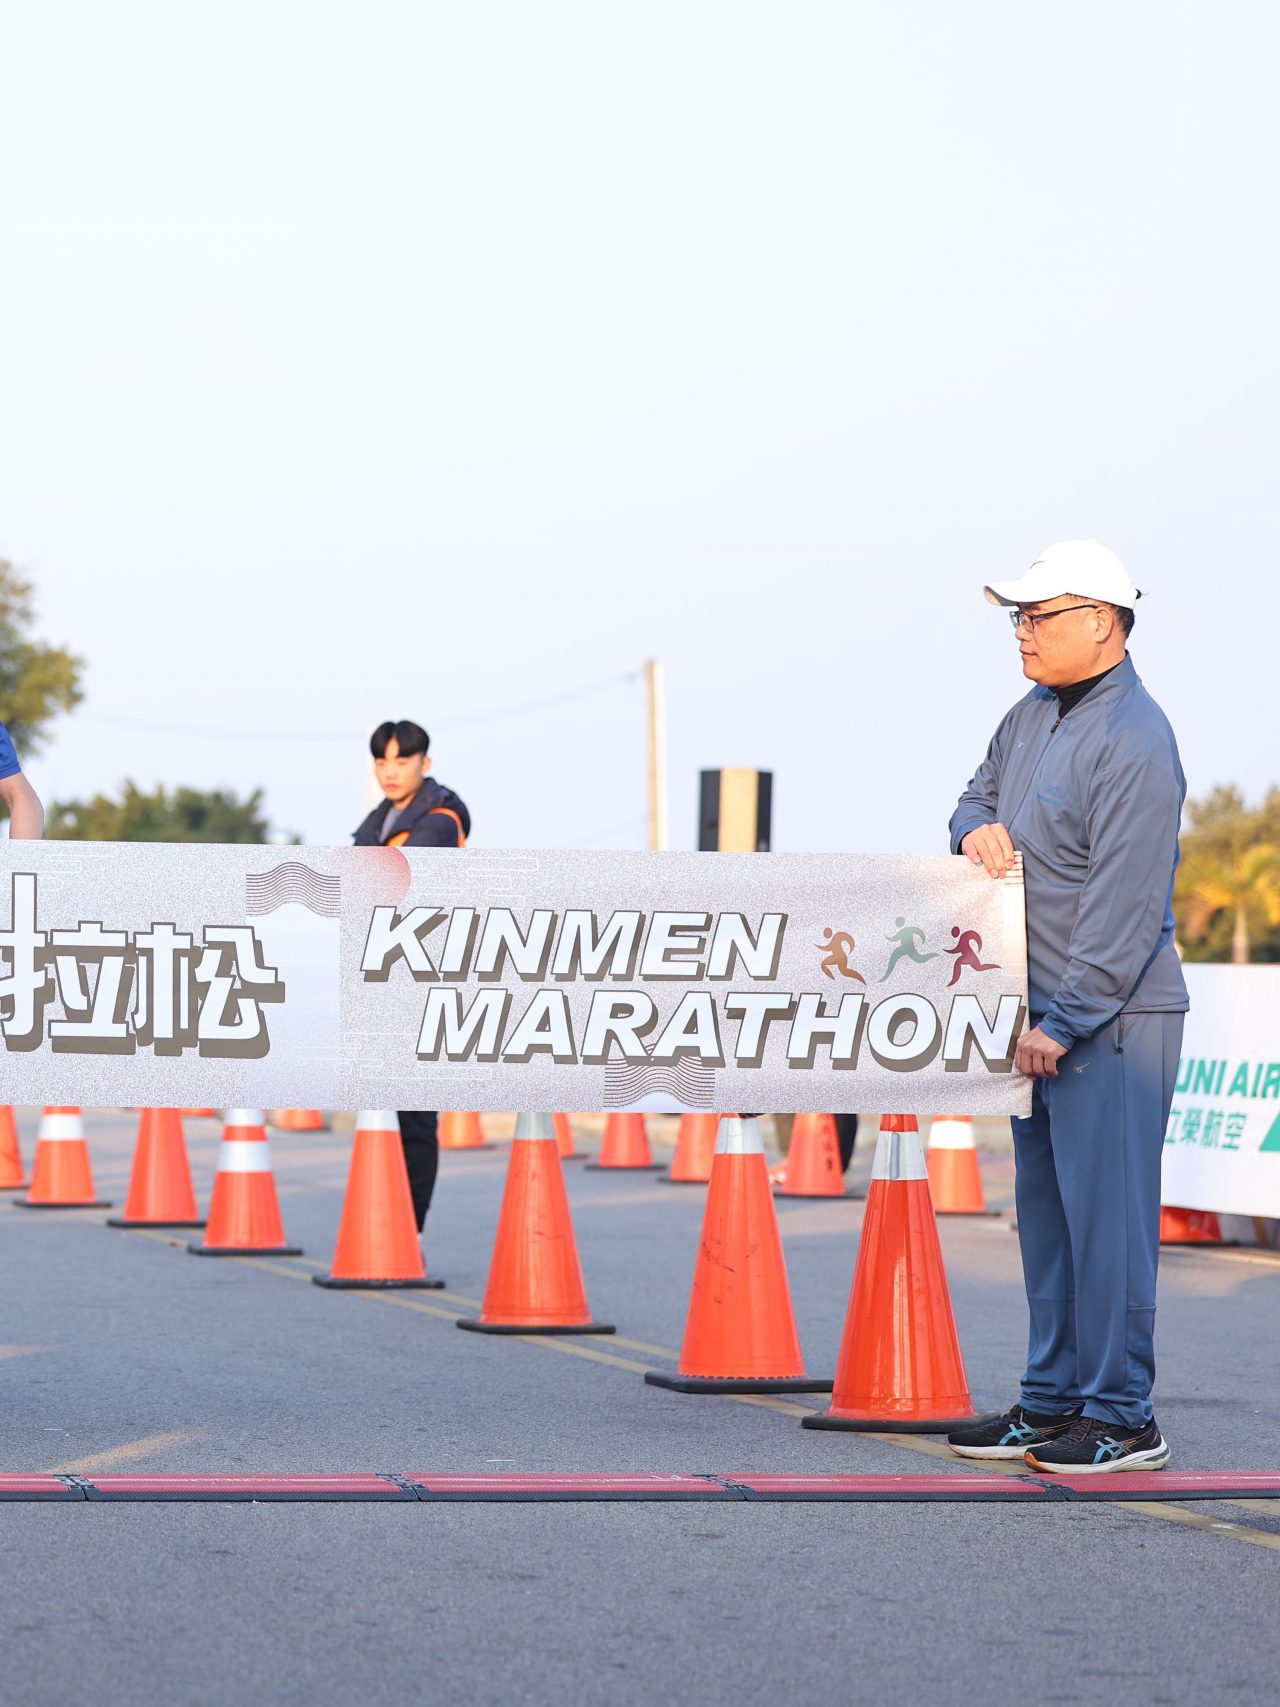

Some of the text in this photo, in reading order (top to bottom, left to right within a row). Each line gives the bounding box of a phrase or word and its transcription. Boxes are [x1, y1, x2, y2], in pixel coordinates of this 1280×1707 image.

[360, 905, 788, 983] KINMEN
[416, 987, 1028, 1073] MARATHON
[1175, 1059, 1227, 1094] UNI
